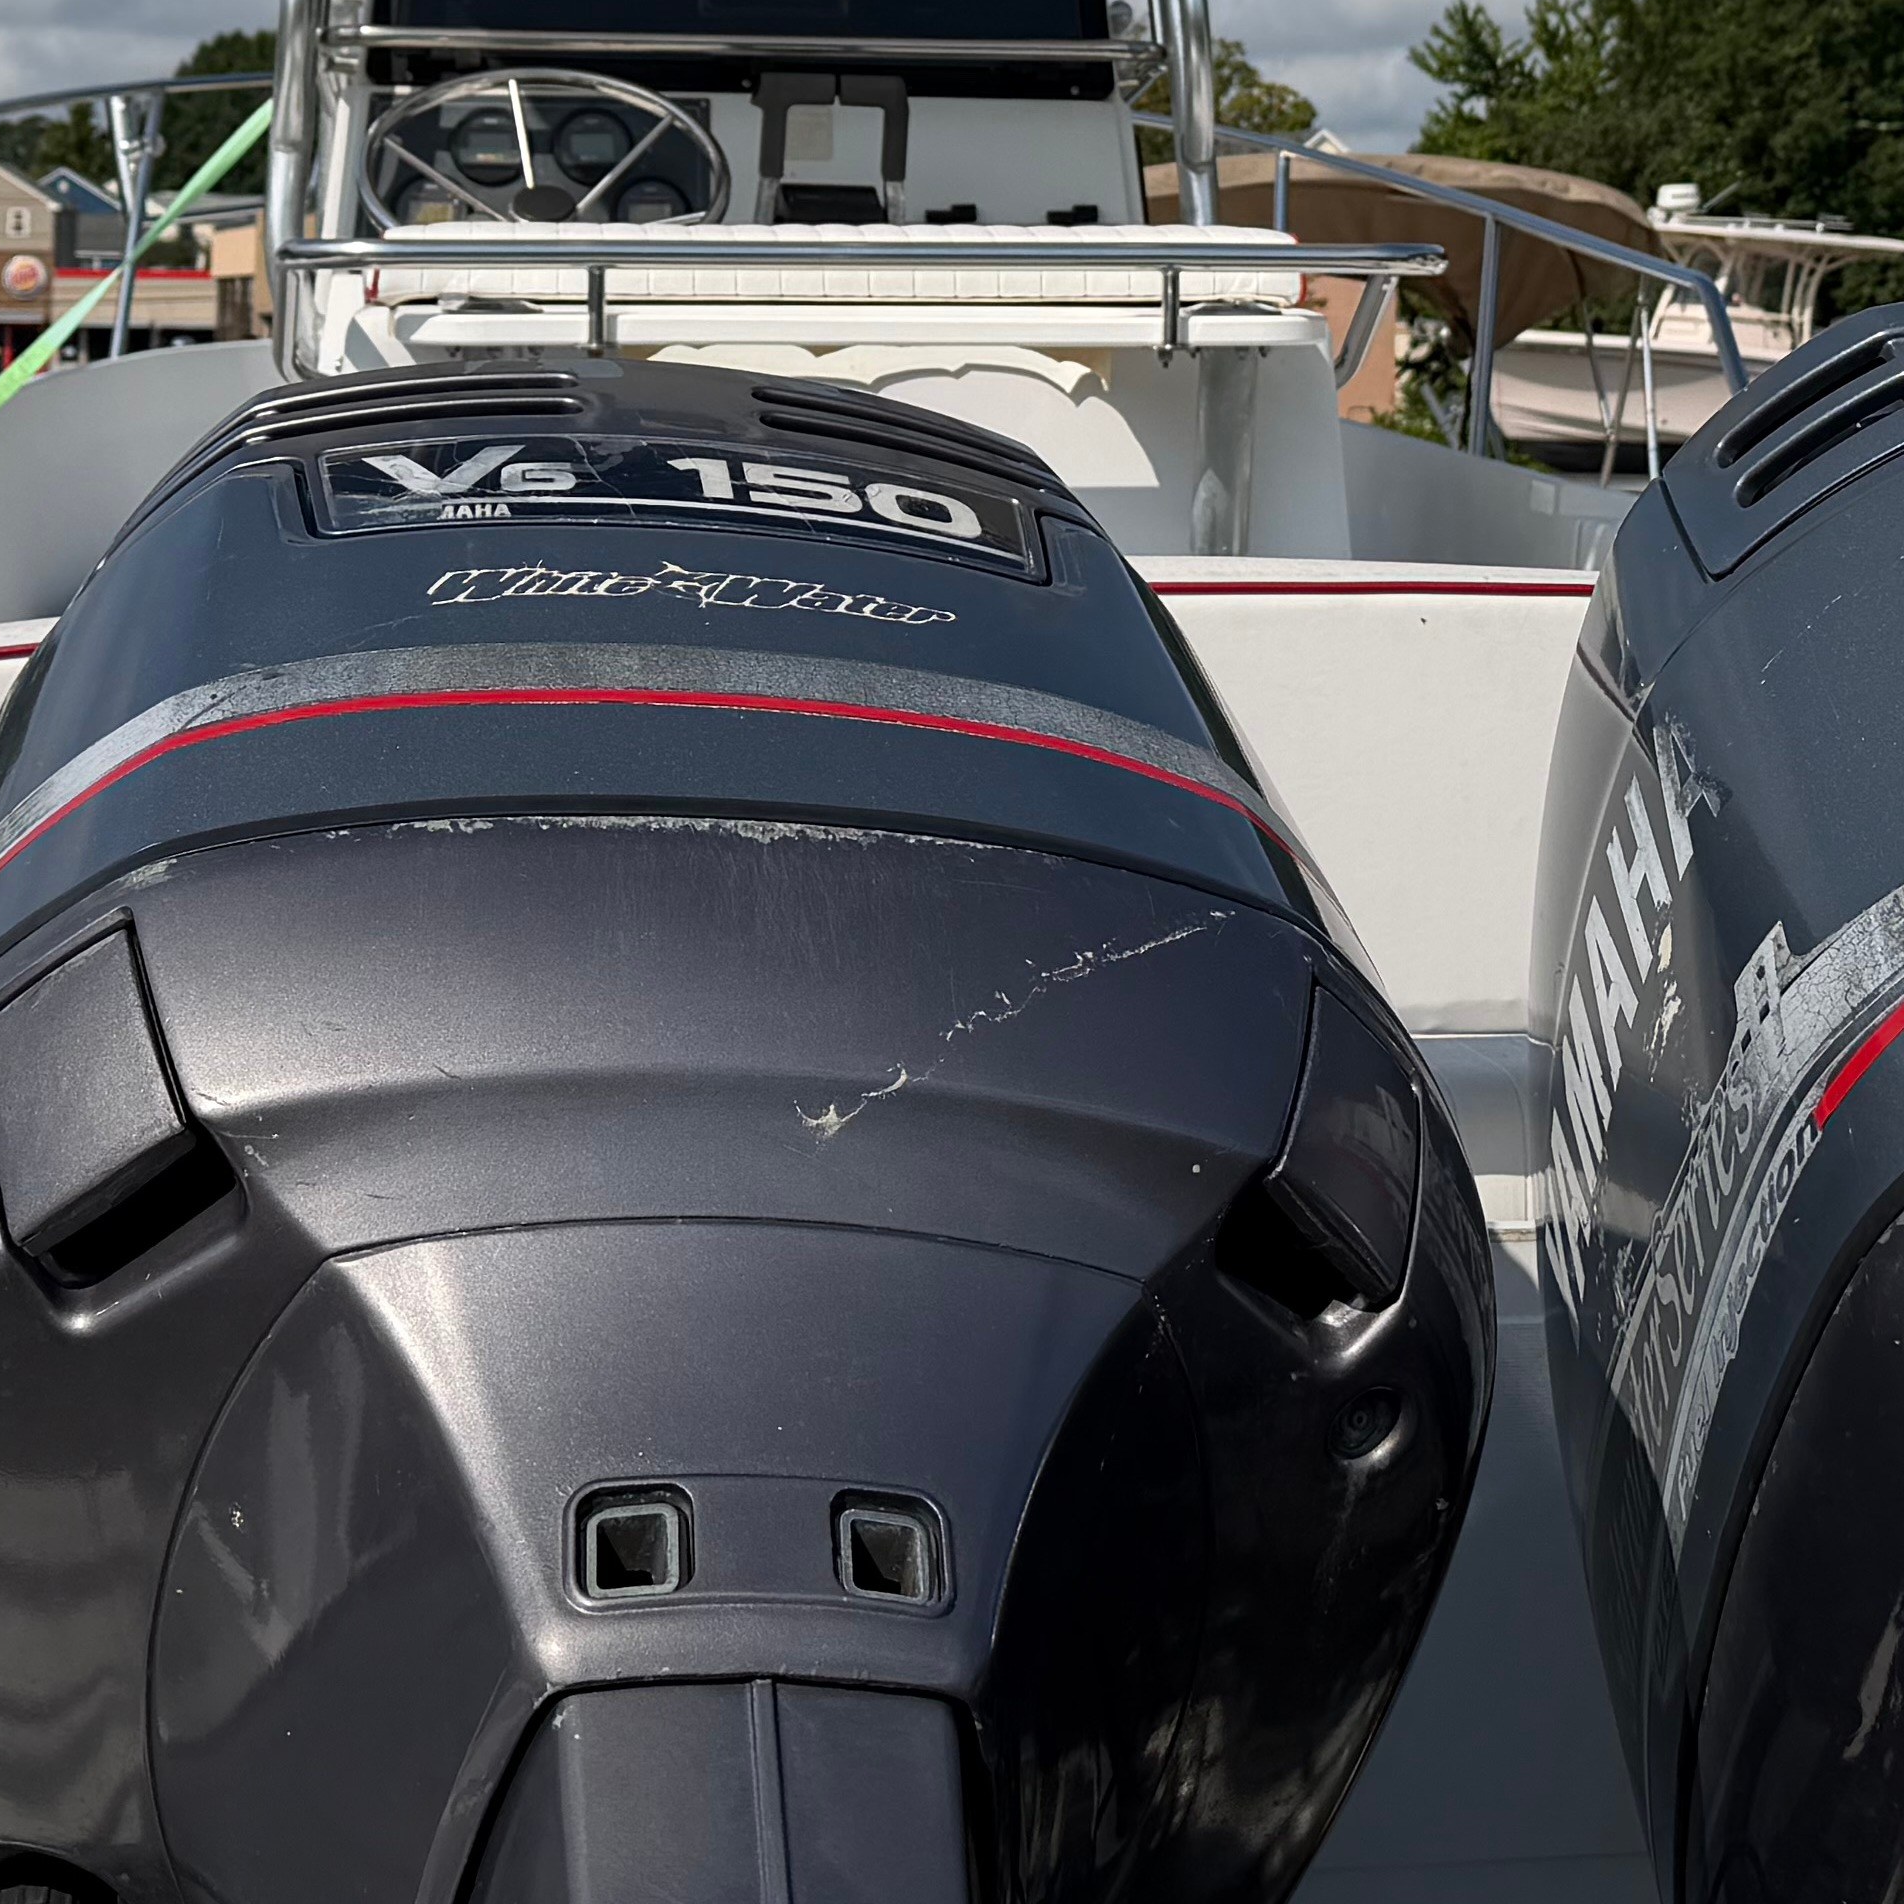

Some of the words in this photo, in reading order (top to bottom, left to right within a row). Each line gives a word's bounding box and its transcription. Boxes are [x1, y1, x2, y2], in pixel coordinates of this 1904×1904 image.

[361, 445, 577, 493] V6
[667, 458, 982, 538] 150
[1545, 714, 1720, 1358] YAMAHA
